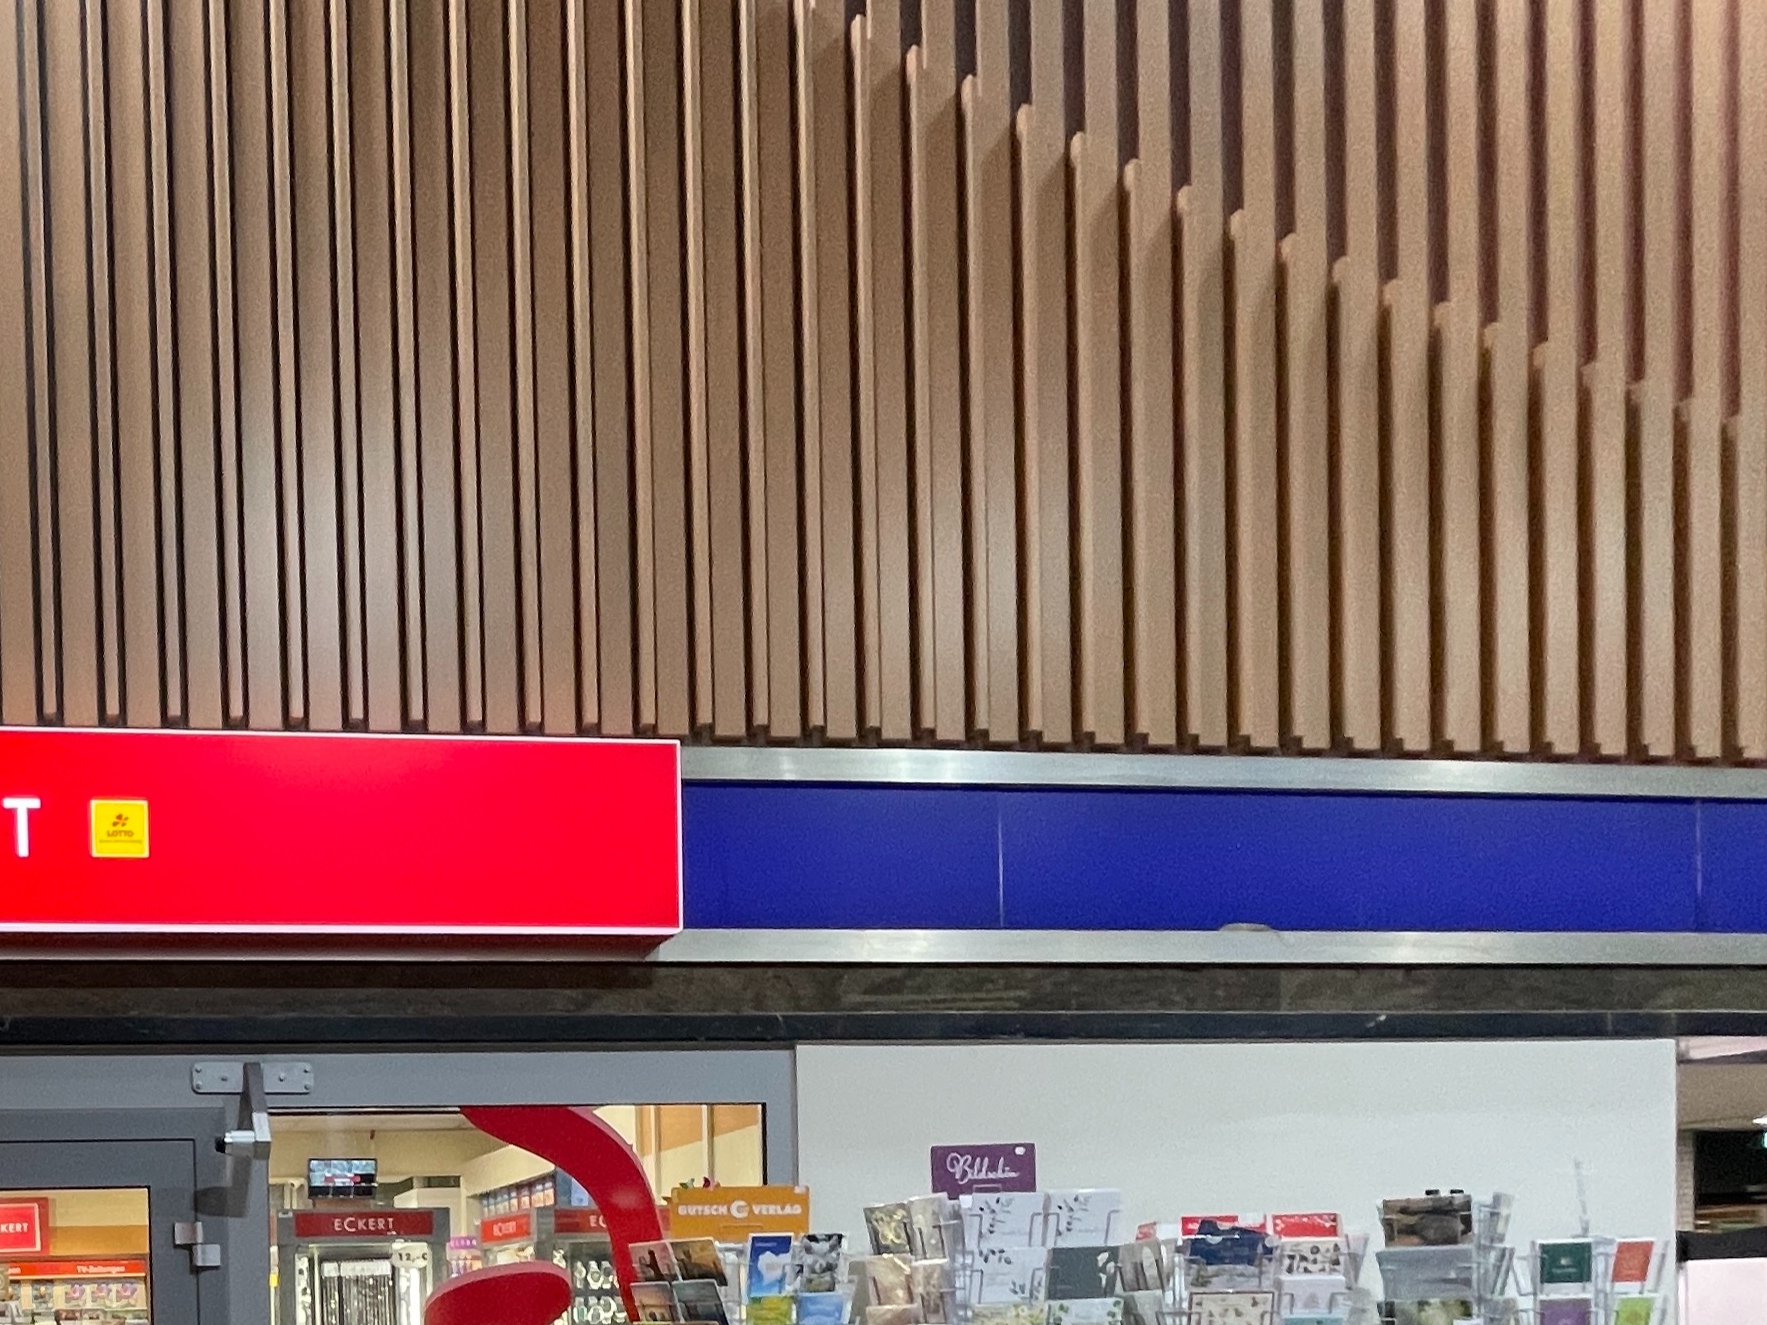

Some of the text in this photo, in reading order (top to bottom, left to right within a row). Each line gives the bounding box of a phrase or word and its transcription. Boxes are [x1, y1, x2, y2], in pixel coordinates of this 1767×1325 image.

[106, 829, 135, 838] LOTTO
[677, 1204, 728, 1216] GUTSCH
[752, 1203, 803, 1215] VERLAG
[333, 1217, 394, 1232] ECKERT
